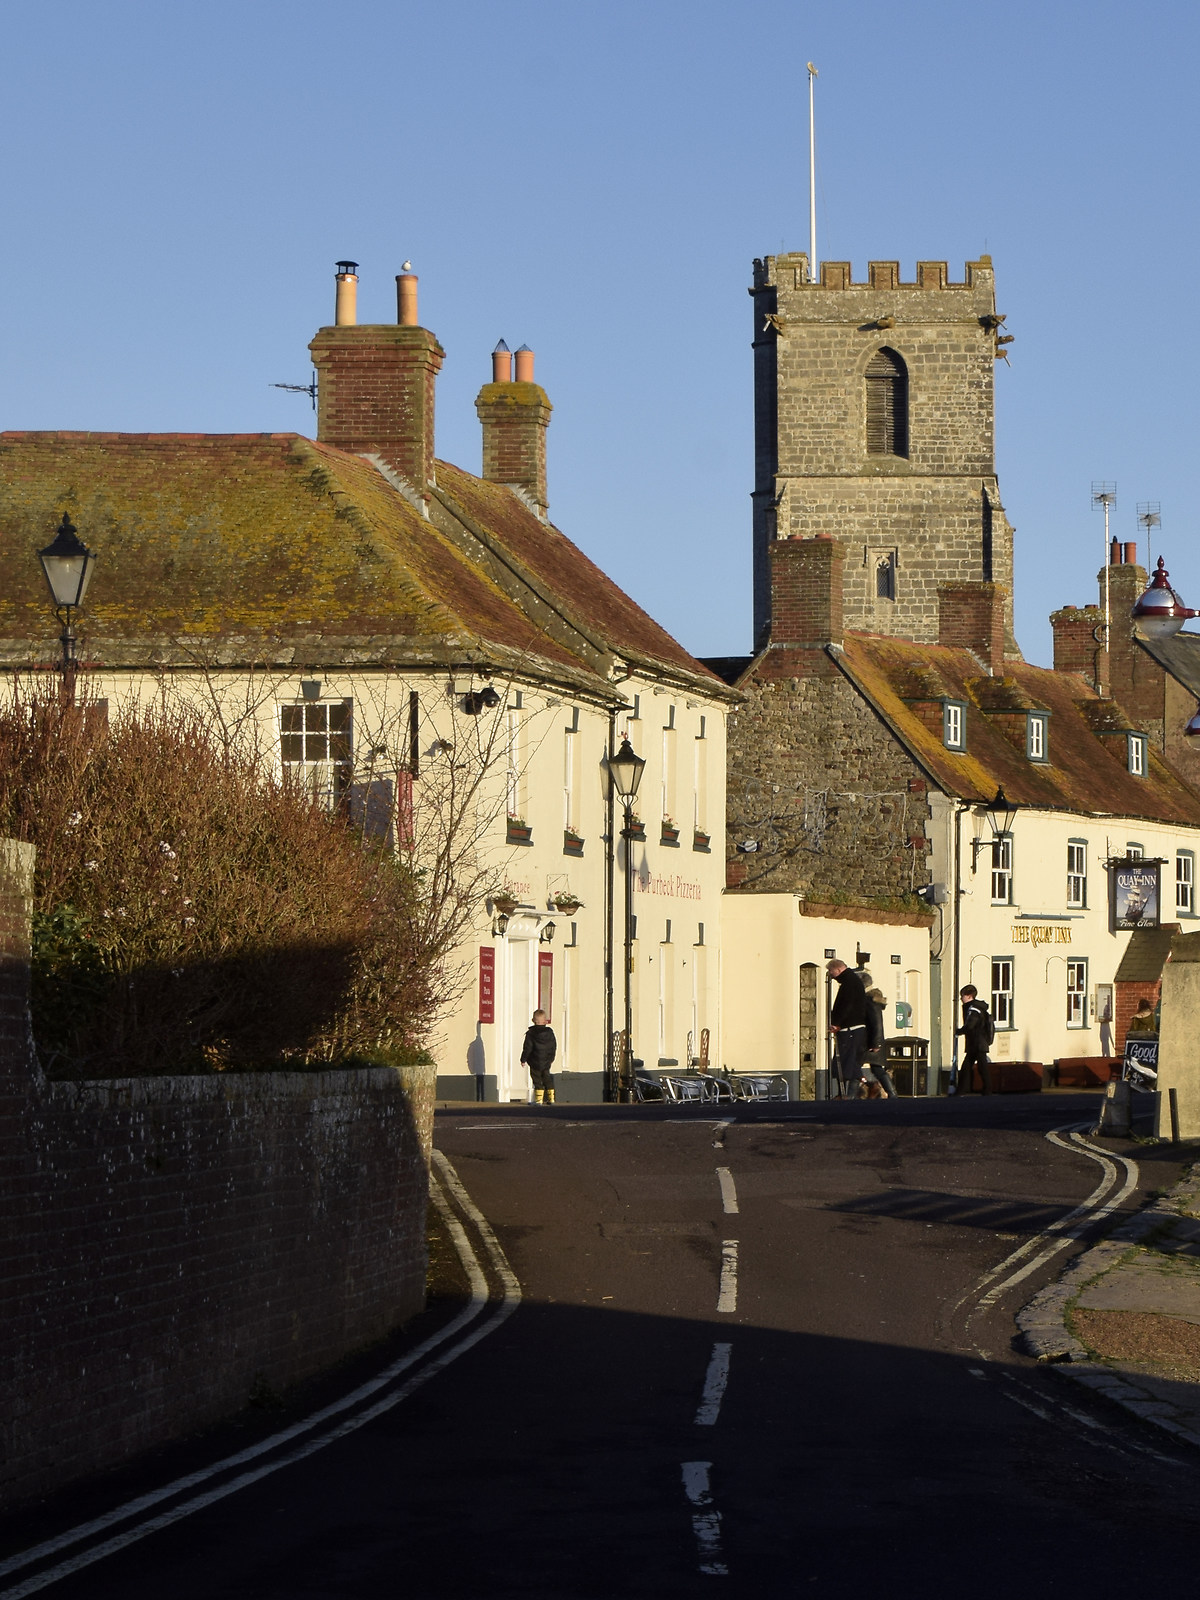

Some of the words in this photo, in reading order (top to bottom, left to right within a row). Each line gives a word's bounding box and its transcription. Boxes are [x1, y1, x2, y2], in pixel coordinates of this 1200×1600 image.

[632, 869, 645, 893] The
[648, 871, 674, 897] Purbeck
[676, 875, 701, 900] Pizzeria
[1118, 875, 1139, 890] QUAY
[1141, 875, 1156, 886] INN
[1011, 925, 1030, 944] THE
[1031, 926, 1053, 948] QUAY
[1054, 926, 1072, 944] INN
[1130, 1043, 1157, 1058] Good
